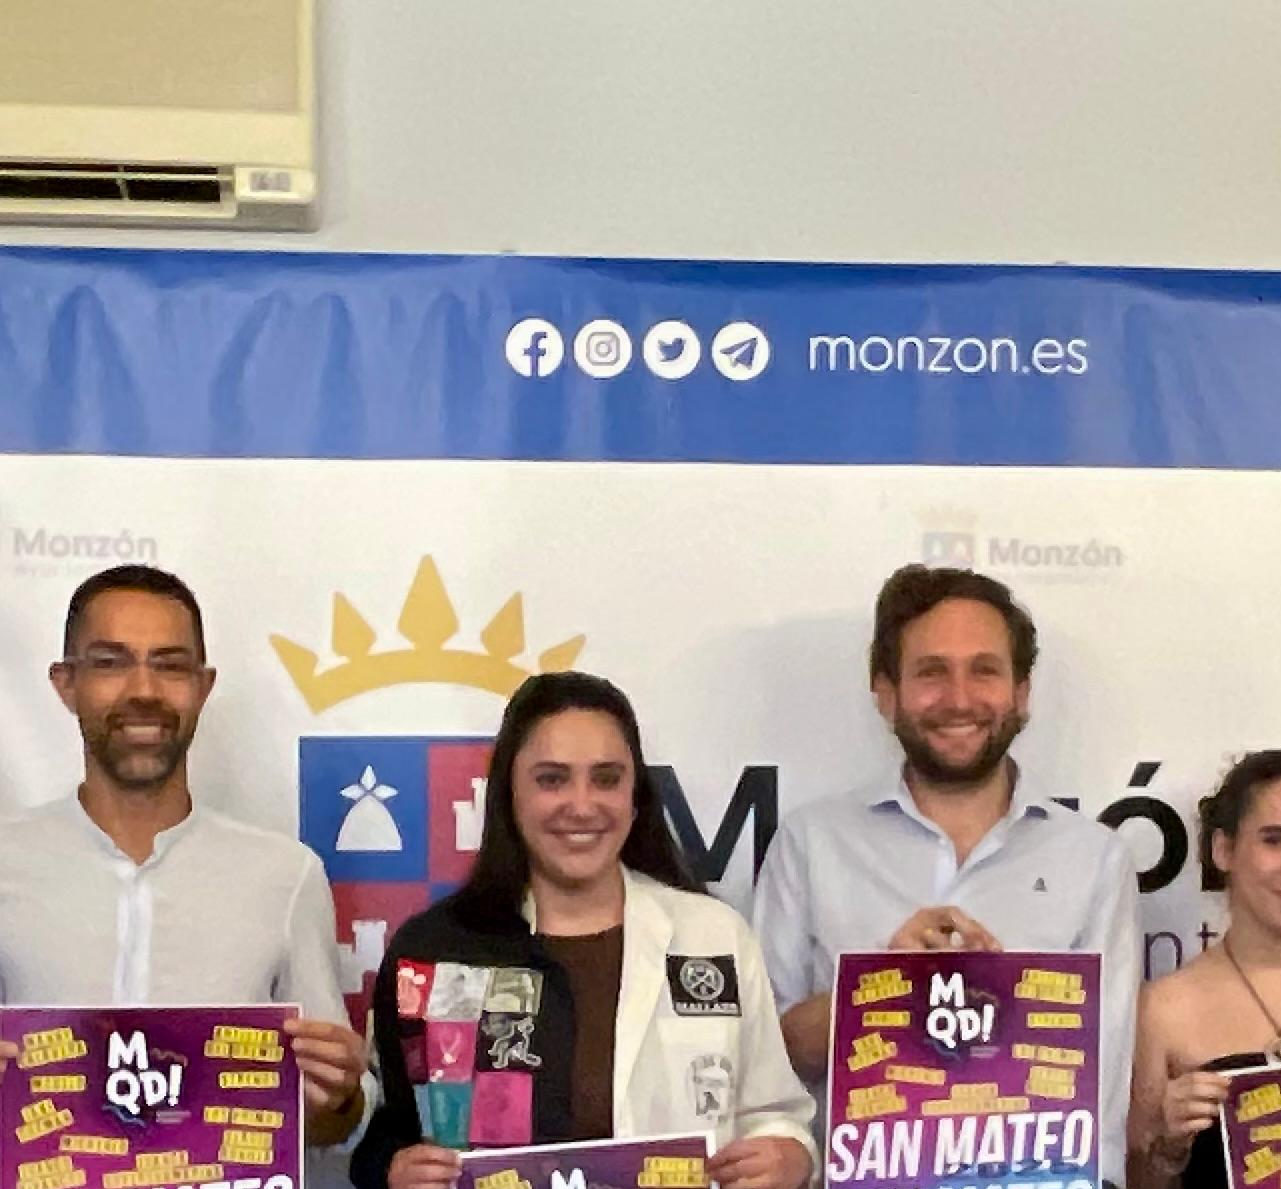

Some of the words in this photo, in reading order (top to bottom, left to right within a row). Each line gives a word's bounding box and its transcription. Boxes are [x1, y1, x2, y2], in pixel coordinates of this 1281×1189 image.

[808, 331, 1089, 376] monzon.es
[14, 528, 158, 560] Monzón
[988, 537, 1124, 567] Monzón
[930, 973, 965, 1007] M
[927, 1004, 994, 1048] QD!
[108, 1030, 149, 1070] M
[106, 1064, 183, 1114] QD!
[829, 1120, 923, 1182] SAN
[934, 1110, 1093, 1176] MATEO
